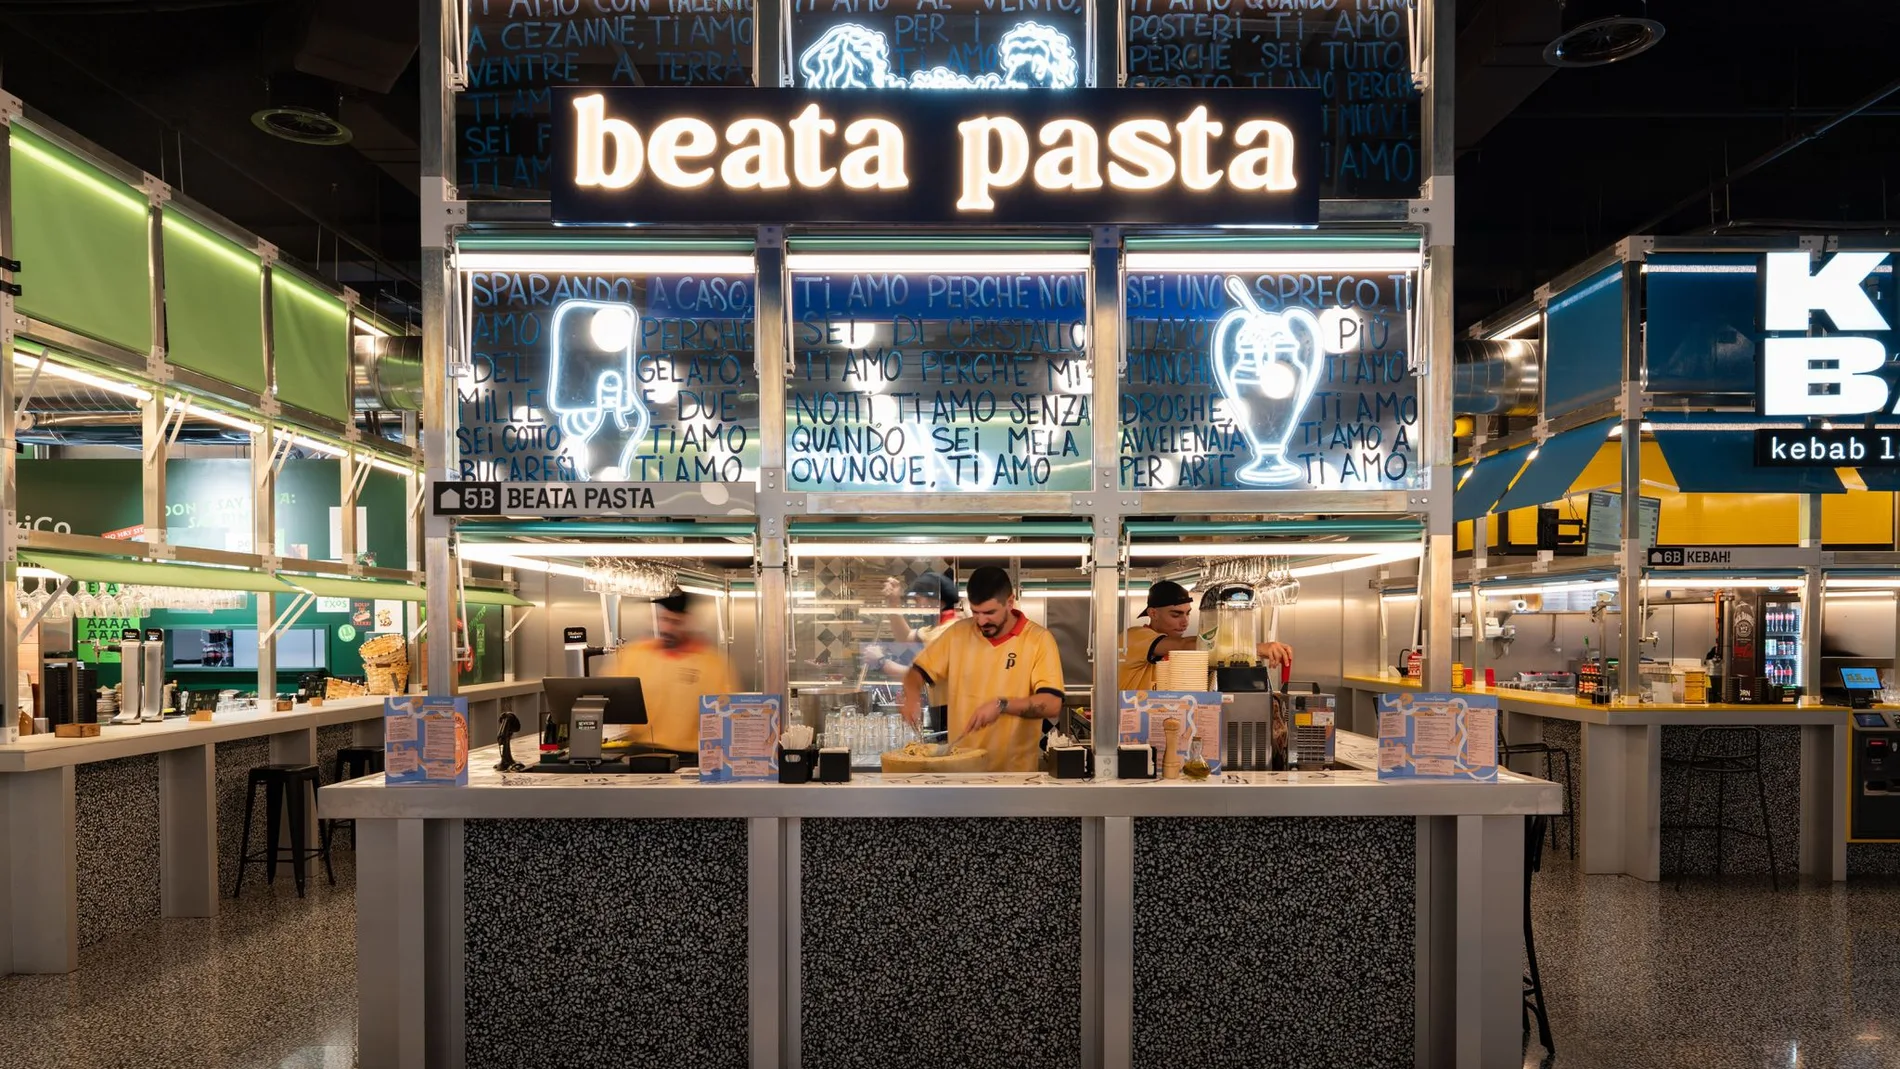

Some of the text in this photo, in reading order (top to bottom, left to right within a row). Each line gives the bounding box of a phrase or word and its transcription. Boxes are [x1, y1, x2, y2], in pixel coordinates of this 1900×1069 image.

[690, 14, 752, 46] AMO
[894, 14, 949, 46] PER
[1333, 11, 1400, 39] AMO
[466, 52, 580, 89] VENTRE
[612, 50, 637, 83] A
[1347, 71, 1417, 100] PERCH
[510, 88, 551, 120] AM
[572, 93, 1297, 212] beata pasta
[1340, 141, 1414, 183] AMO
[511, 153, 551, 189] AM
[472, 272, 633, 307] SPARANDO
[652, 275, 671, 310] A
[849, 273, 909, 309] AMO
[1037, 274, 1086, 310] NON
[1177, 274, 1225, 310] UNO
[472, 311, 541, 346] AMO
[1152, 314, 1209, 350] AMO
[473, 352, 531, 384] DEL
[842, 348, 903, 384] AMO
[1355, 350, 1406, 385] AMO
[1765, 337, 1900, 416] B
[677, 388, 739, 423] DUE
[931, 389, 997, 425] AMO
[1009, 391, 1091, 428] SENZA
[1356, 391, 1418, 426] AMO
[680, 423, 748, 454] AMO
[791, 425, 906, 457] QUANDO
[1008, 426, 1082, 458] MELA
[1119, 423, 1248, 453] AVVELENATA
[1329, 422, 1382, 451] AMO
[1391, 424, 1412, 453] A
[1771, 436, 1900, 460] kebab l
[676, 455, 743, 482] AMO
[791, 455, 937, 488] OVUNQUE,
[993, 453, 1052, 486] AMO
[1119, 454, 1164, 488] PER
[1340, 452, 1408, 484] AMO
[463, 488, 656, 510] 5B BEATA PASTA
[1664, 550, 1731, 563] 6B KEBAH!
